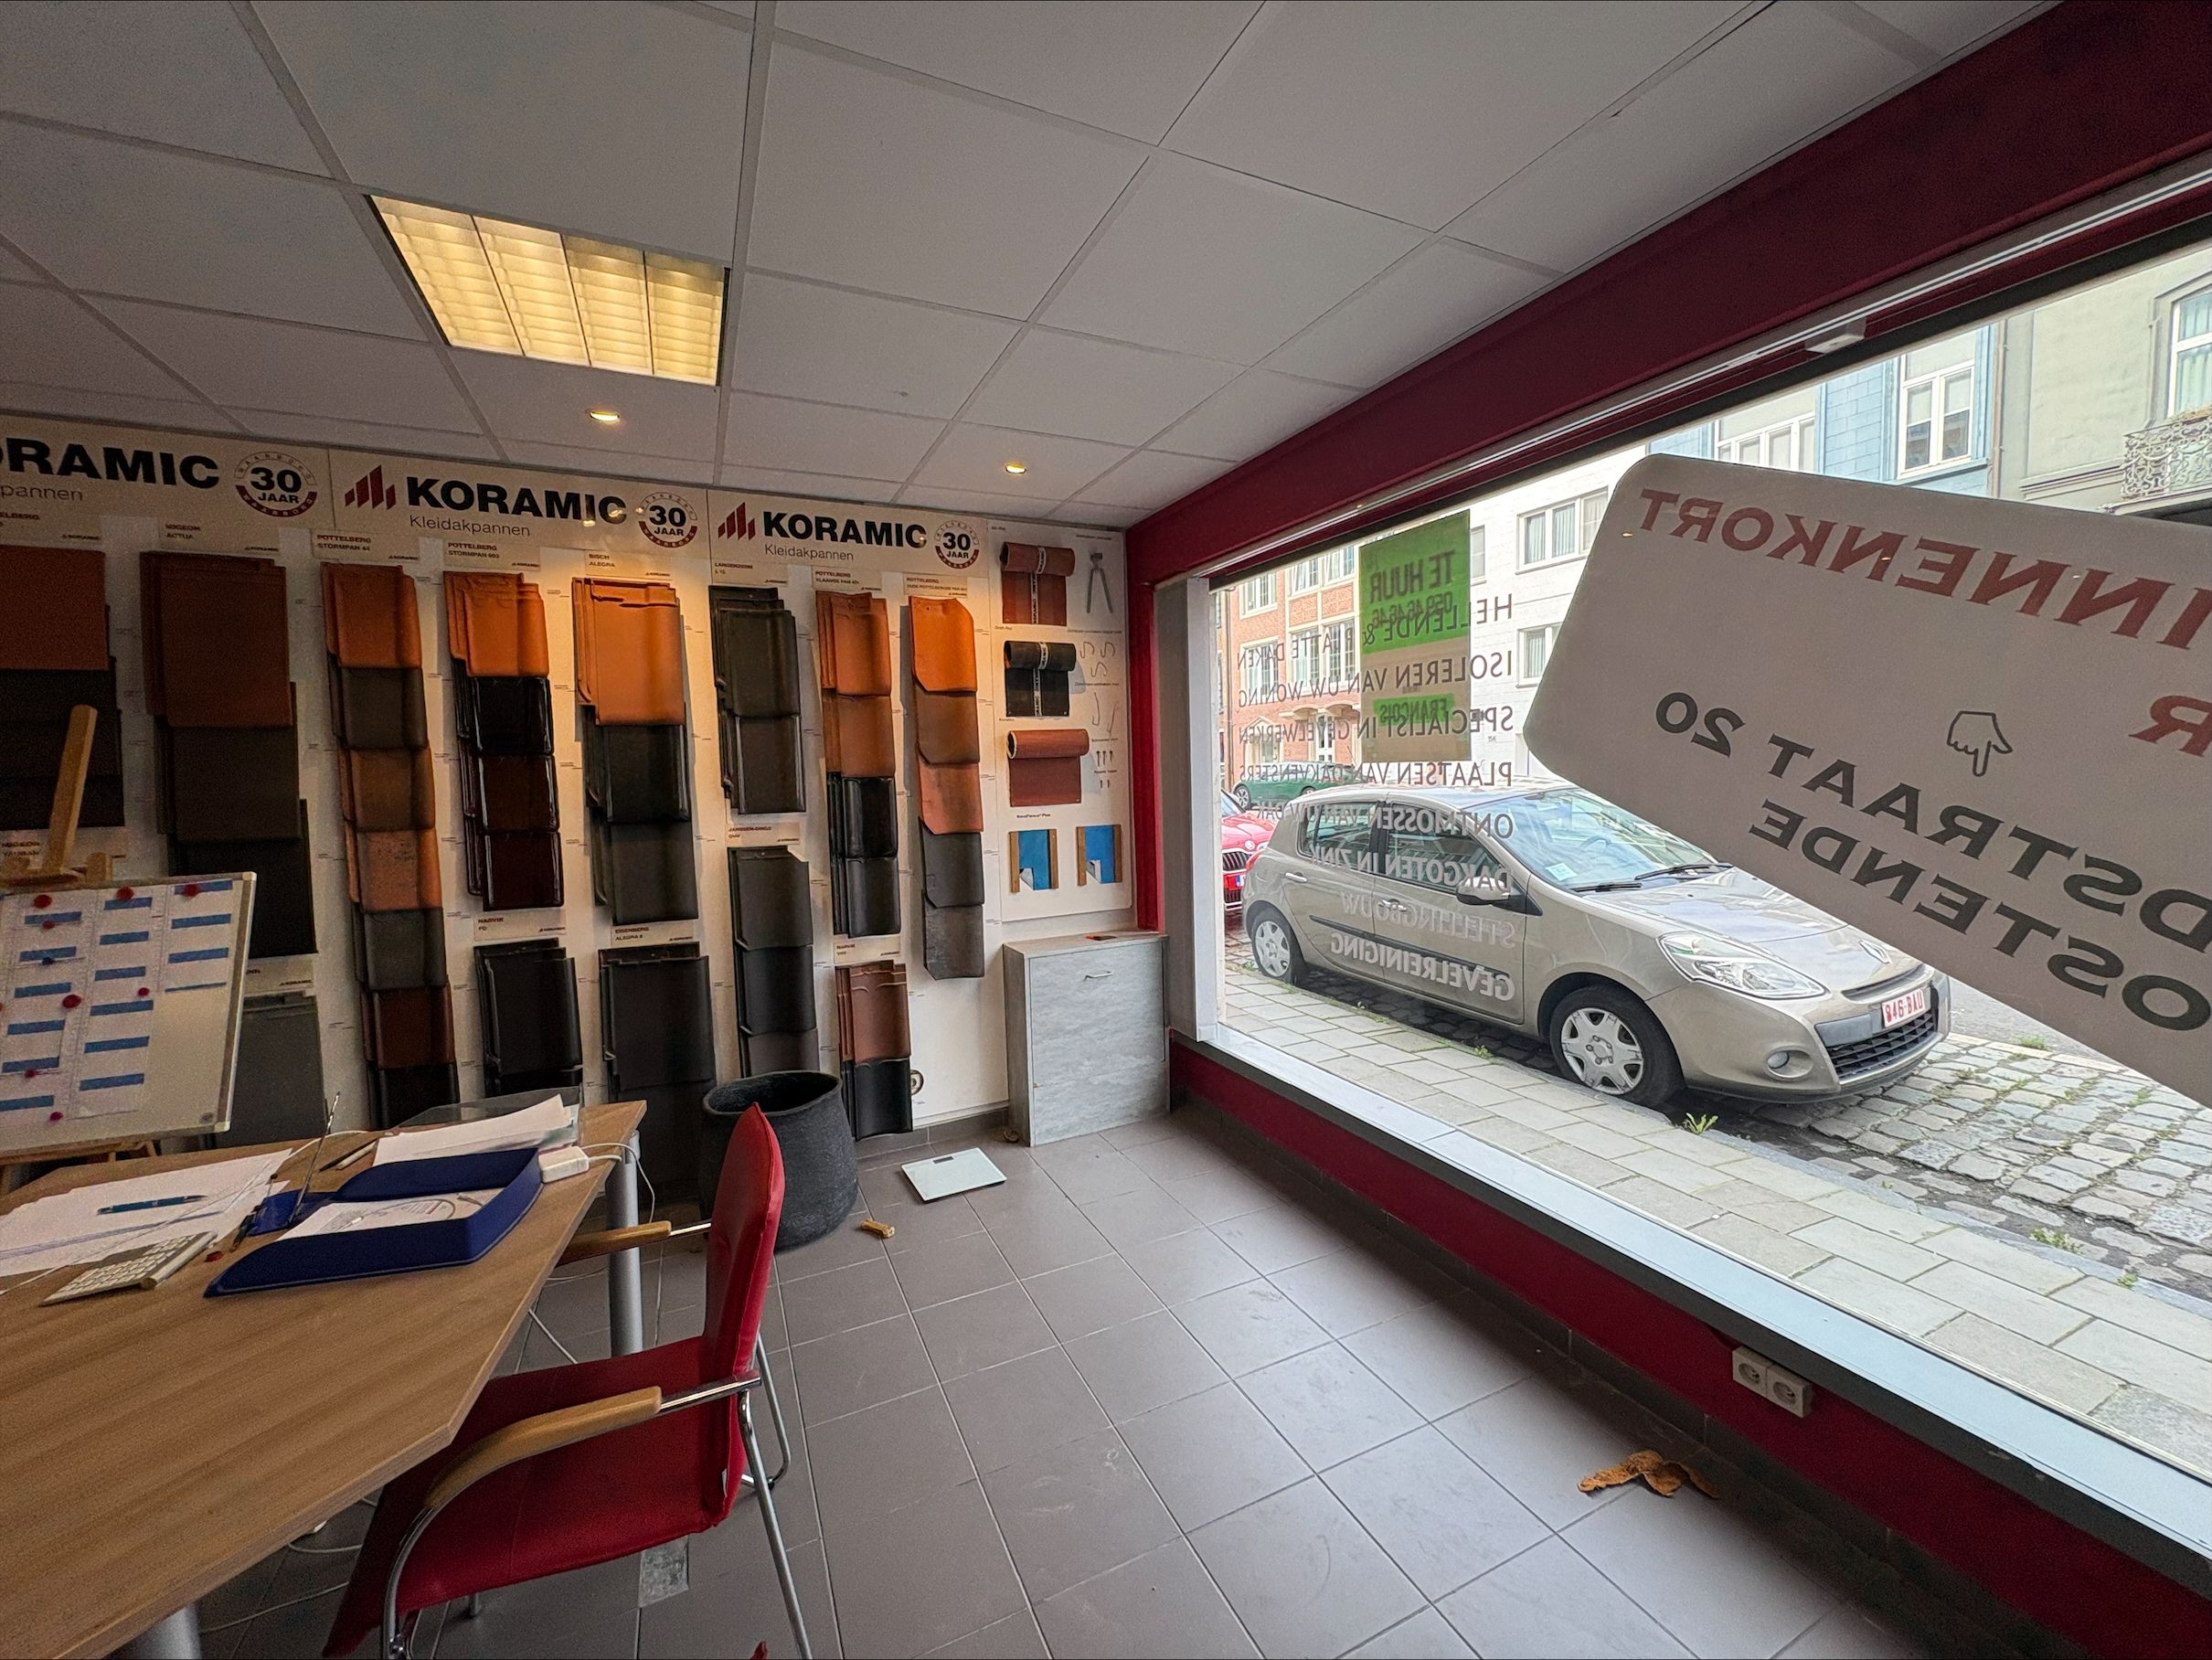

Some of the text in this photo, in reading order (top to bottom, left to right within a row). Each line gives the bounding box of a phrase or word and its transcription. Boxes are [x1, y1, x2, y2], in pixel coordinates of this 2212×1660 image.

[0, 437, 220, 490] RAMIC
[250, 466, 302, 494] 30
[257, 493, 299, 504] JAAR
[406, 475, 627, 525] KORAMIC
[649, 505, 686, 527] 30
[409, 515, 531, 537] Kleidakpannen
[654, 527, 684, 537] JAAR
[762, 510, 927, 549] KORAMIC
[316, 534, 372, 544] POTTELBERG
[448, 541, 498, 551] POTTELBERG
[942, 532, 972, 550] 30
[764, 543, 855, 562] Kleidakpannen
[946, 550, 969, 559] JAAR
